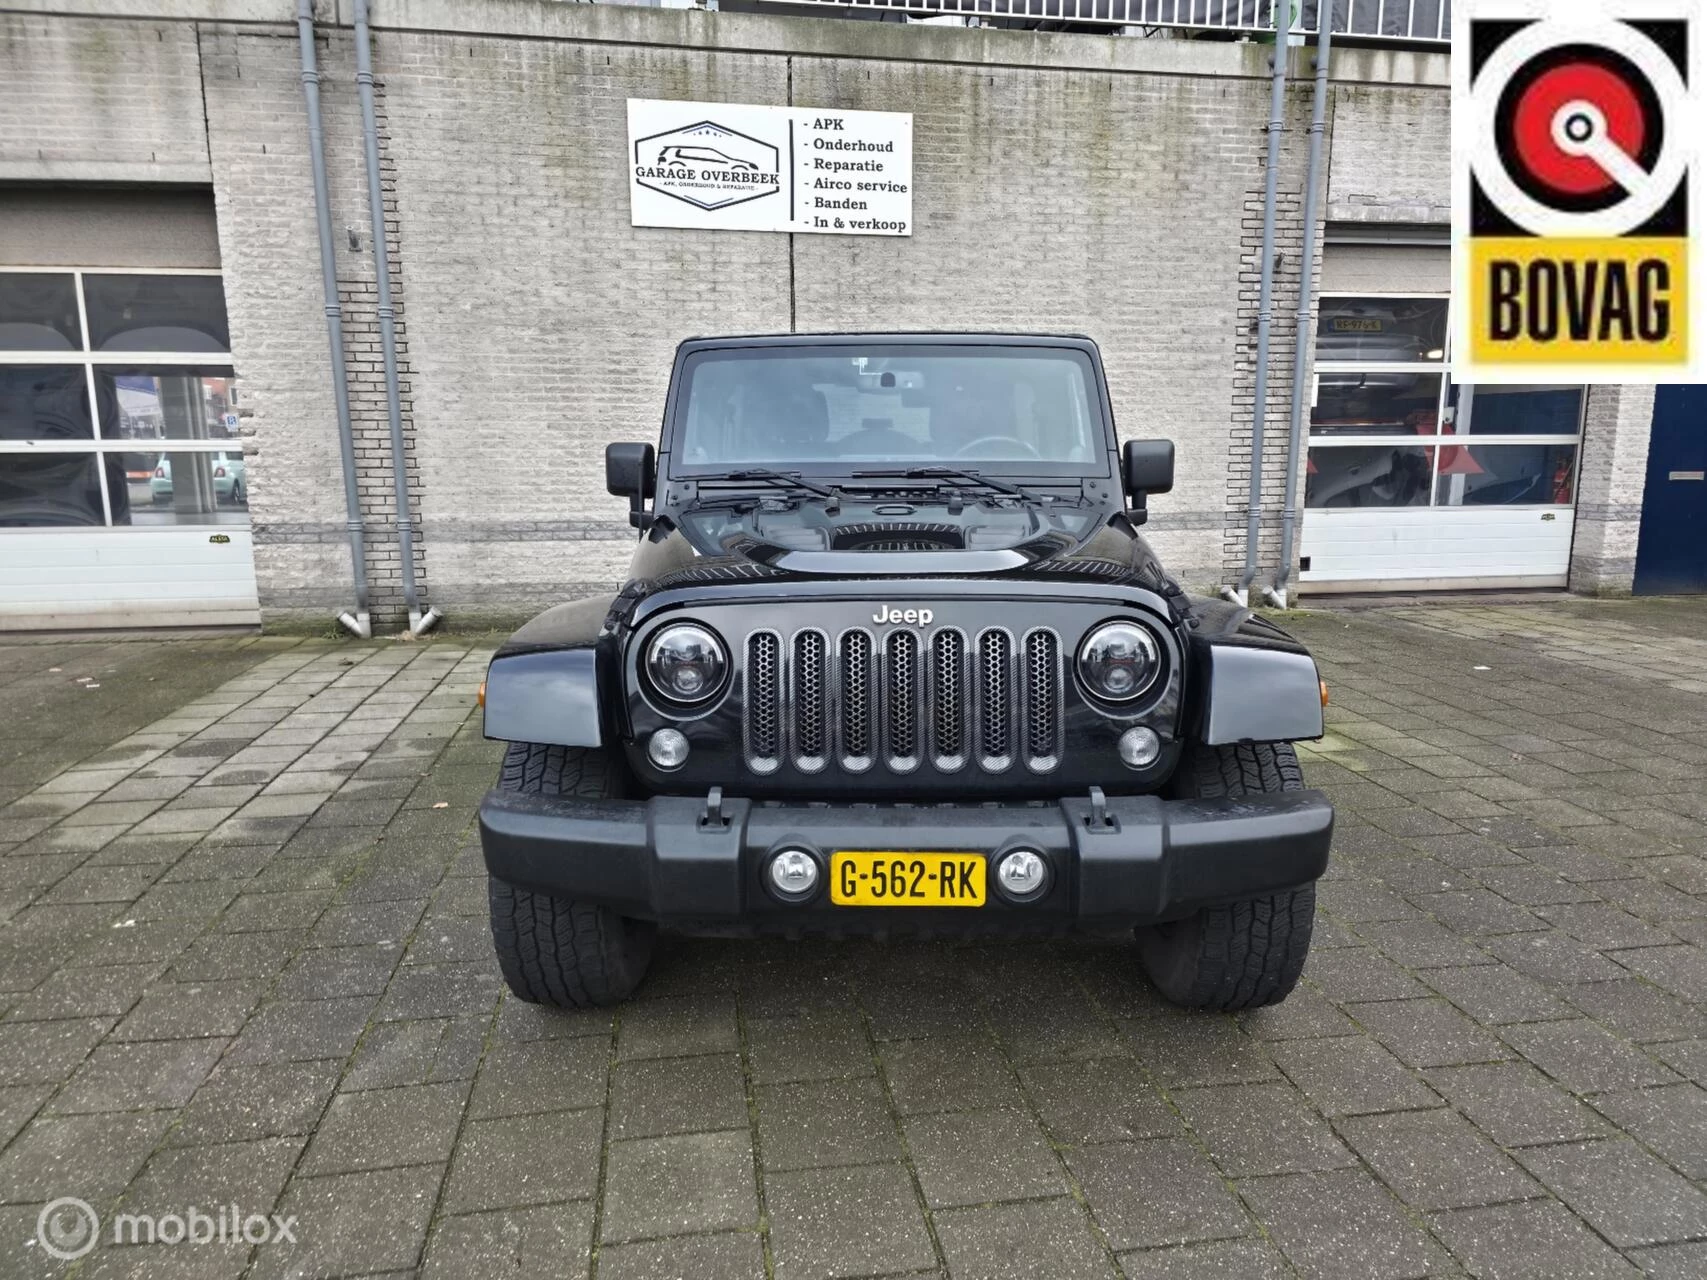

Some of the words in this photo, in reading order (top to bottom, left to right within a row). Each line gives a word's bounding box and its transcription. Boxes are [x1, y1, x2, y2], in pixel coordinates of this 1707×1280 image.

[813, 117, 844, 130] APK
[813, 138, 894, 152] Onderhoud
[814, 158, 884, 173] Reparatie
[635, 166, 696, 180] GARAGE
[701, 170, 780, 184] OVERBEEK
[813, 177, 852, 190] Airco
[857, 180, 908, 193] service
[814, 196, 868, 210] Banden
[813, 216, 829, 228] In
[833, 217, 845, 229] &
[849, 218, 906, 233] verkoop
[872, 604, 934, 628] Jeep
[841, 860, 977, 899] G-562-RK
